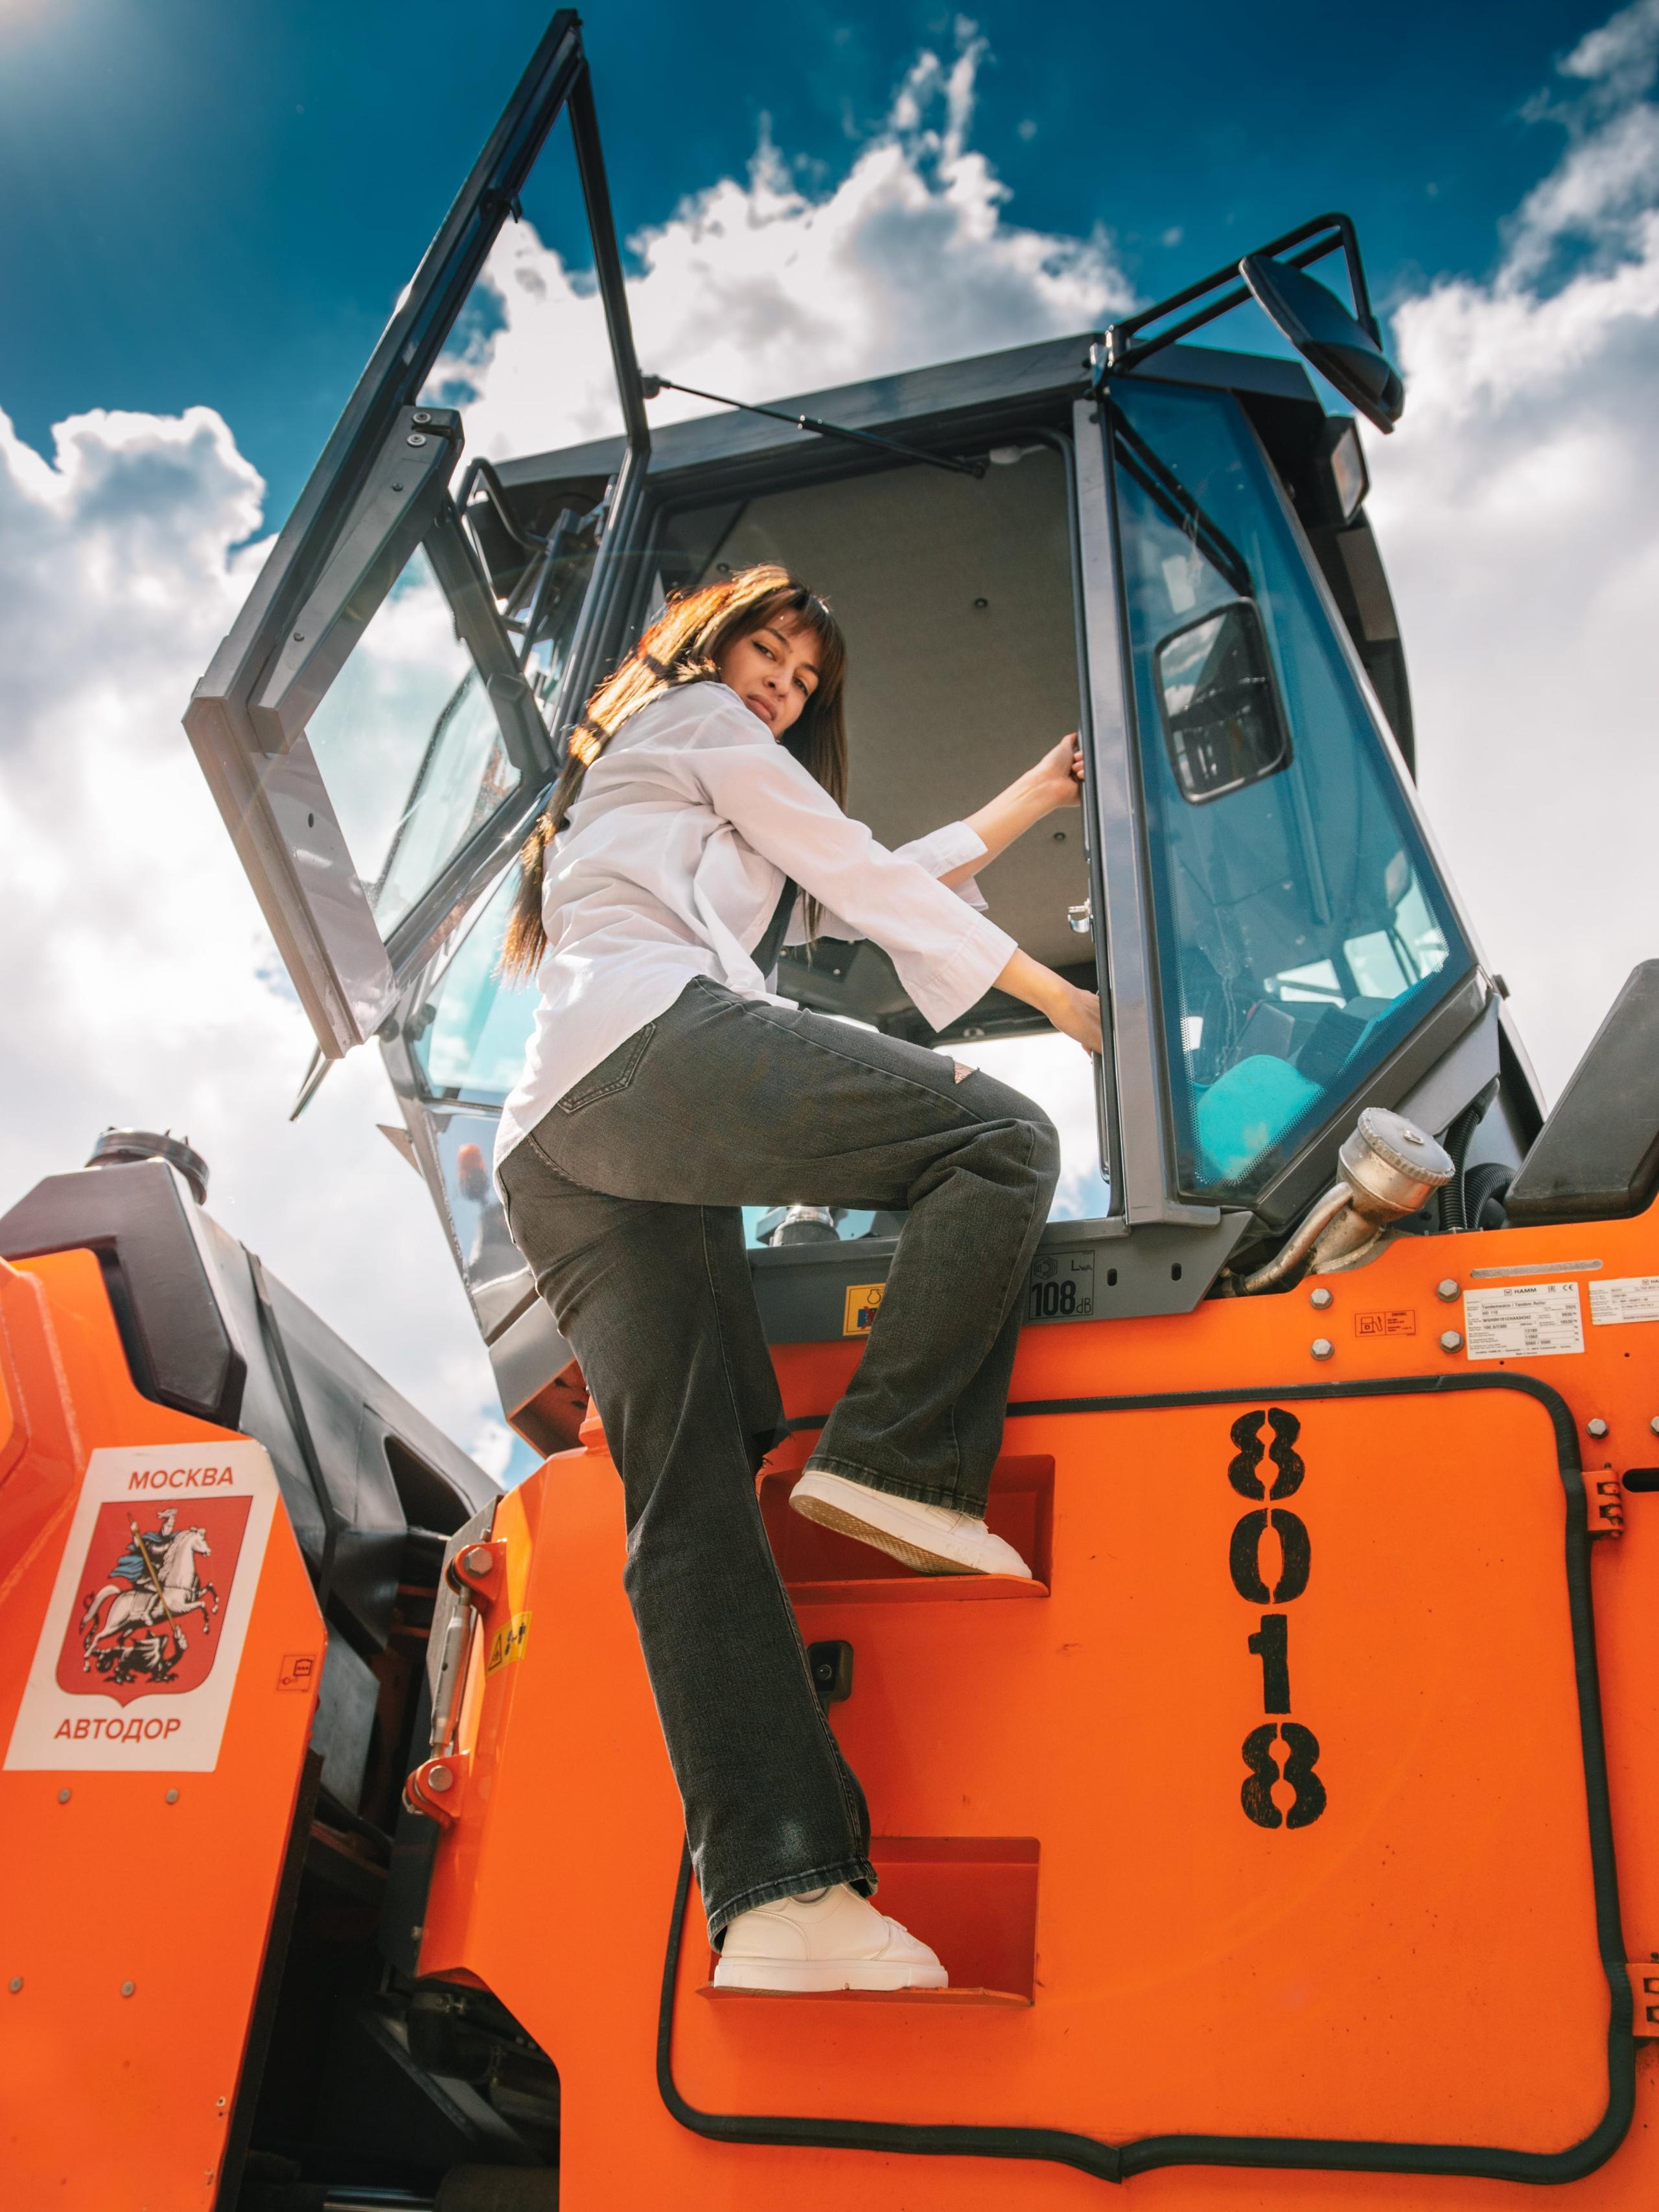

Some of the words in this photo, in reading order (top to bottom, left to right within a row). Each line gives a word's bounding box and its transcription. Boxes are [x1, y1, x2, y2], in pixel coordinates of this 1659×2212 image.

[1032, 1280, 1076, 1317] 108
[1076, 1298, 1091, 1314] dB
[128, 1467, 234, 1490] МОСКВА
[1227, 1407, 1327, 1830] 8018
[54, 1719, 181, 1743] АВТОДОР
